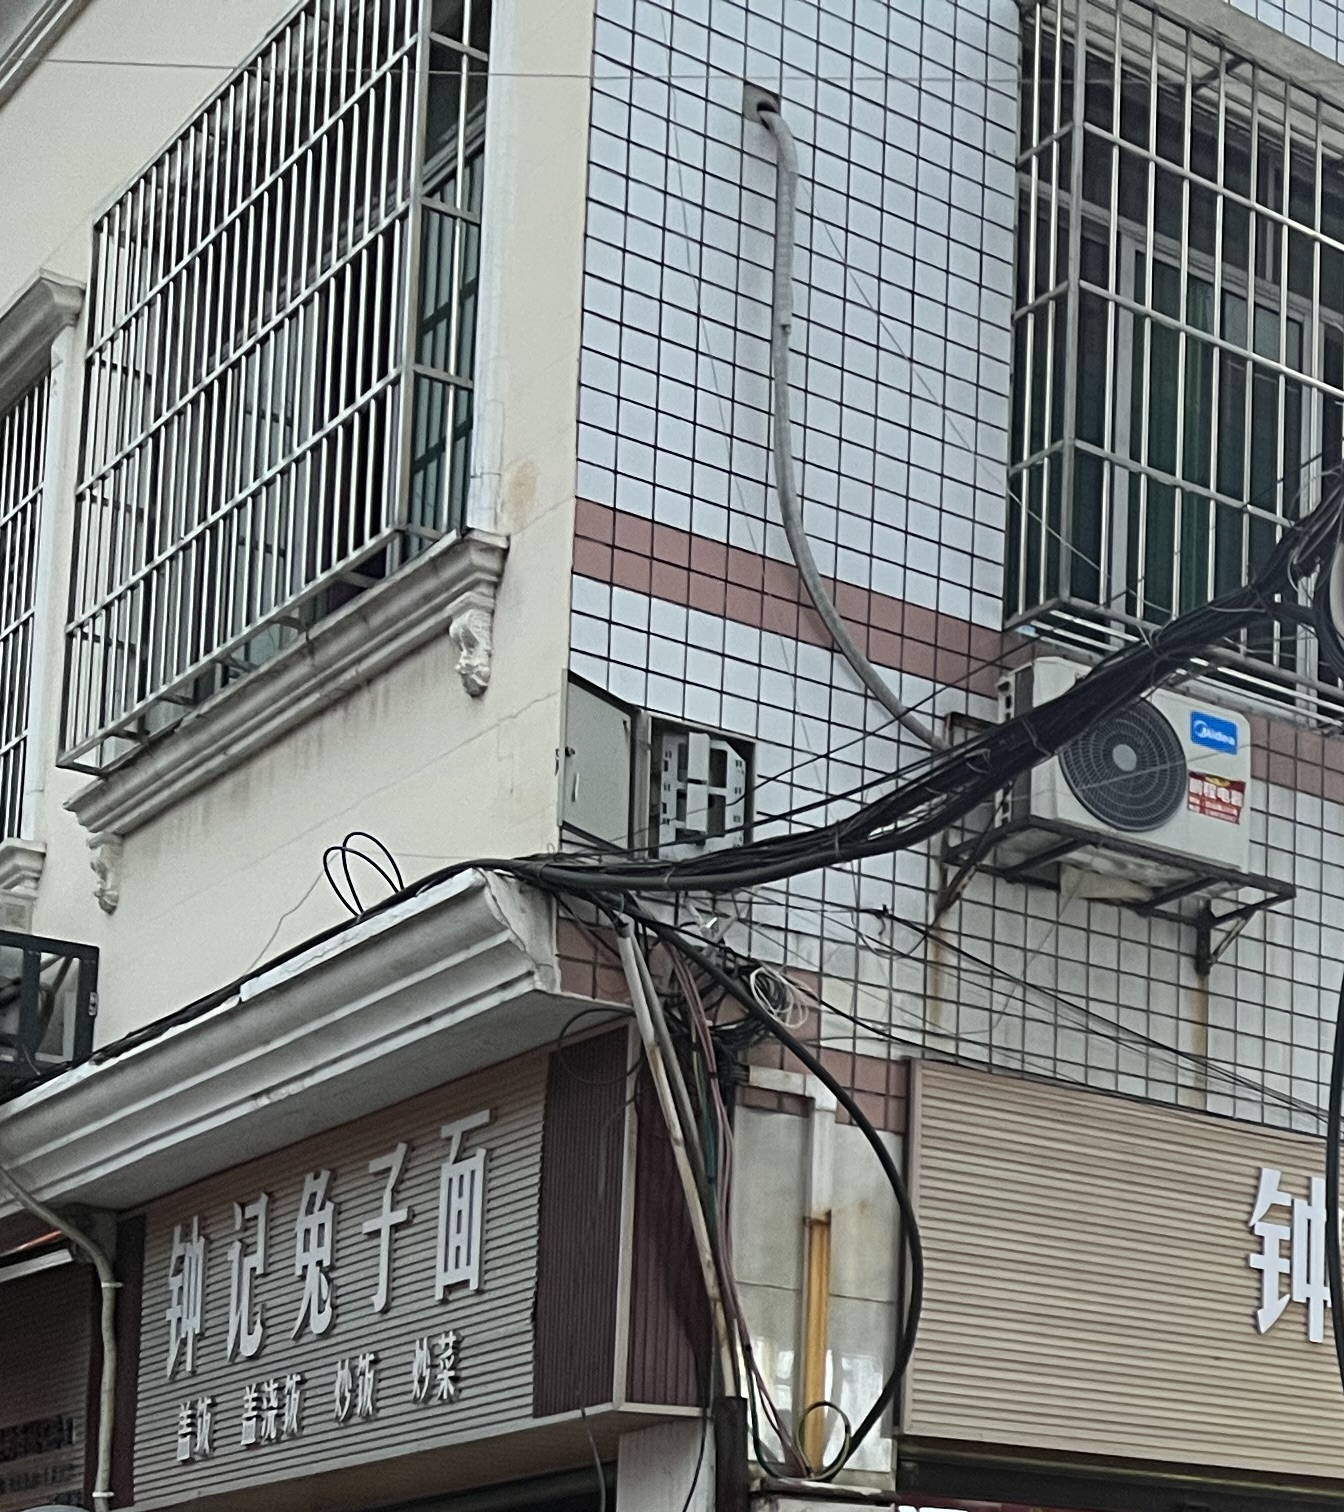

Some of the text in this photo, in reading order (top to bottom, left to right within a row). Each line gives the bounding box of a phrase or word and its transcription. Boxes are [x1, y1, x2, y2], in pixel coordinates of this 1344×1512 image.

[1193, 719, 1236, 746] Midea
[164, 1108, 491, 1381] 钟记兔子面
[333, 1352, 376, 1423] 炒饭
[412, 1330, 460, 1402] 炒菜
